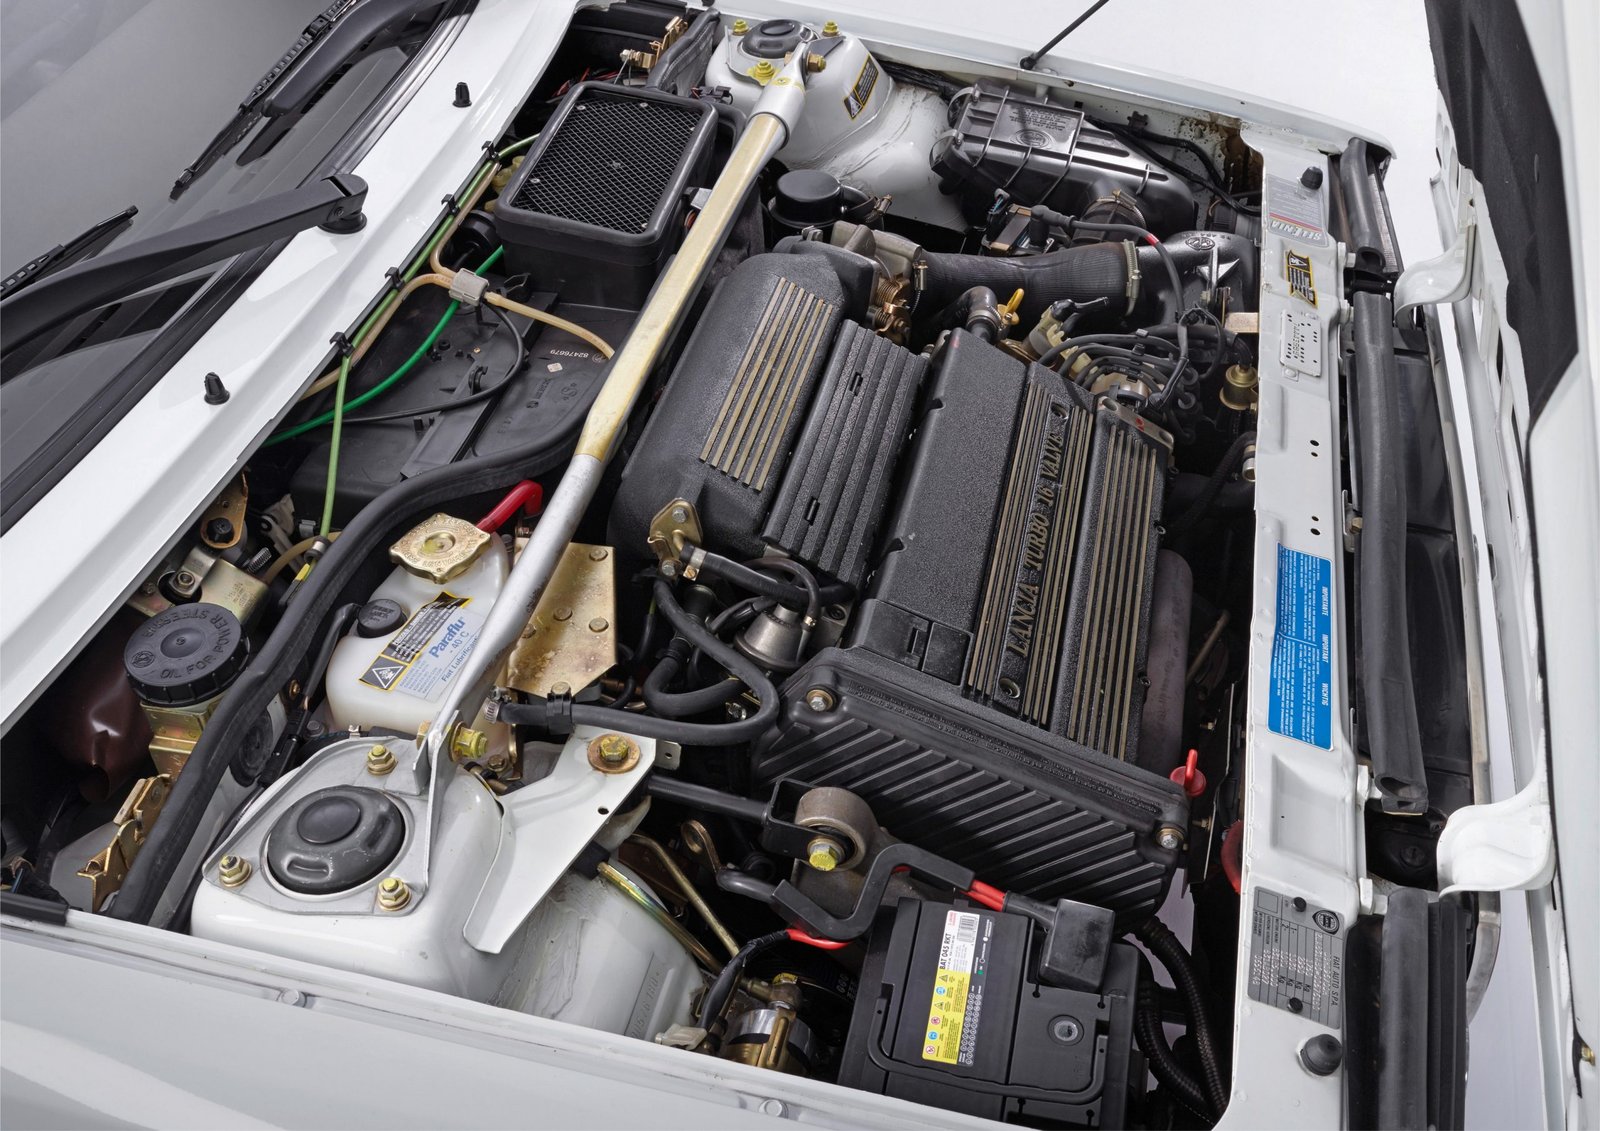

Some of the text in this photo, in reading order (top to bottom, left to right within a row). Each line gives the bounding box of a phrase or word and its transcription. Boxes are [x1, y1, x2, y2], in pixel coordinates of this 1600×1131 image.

[1271, 221, 1322, 240] SELENIA
[550, 349, 589, 358] 82476679
[1009, 431, 1064, 658] LANCIA TURBO 16 VALVE
[429, 619, 466, 658] Paraflu
[160, 668, 182, 679] OIL
[186, 655, 216, 674] FOR
[210, 612, 232, 654] POWER
[441, 668, 454, 682] Fiat
[944, 933, 952, 944] RKT
[942, 945, 950, 958] 045
[1278, 974, 1285, 984] Kg
[1287, 978, 1293, 987] Kg
[1295, 980, 1302, 990] Kg
[1304, 983, 1310, 992] Kg
